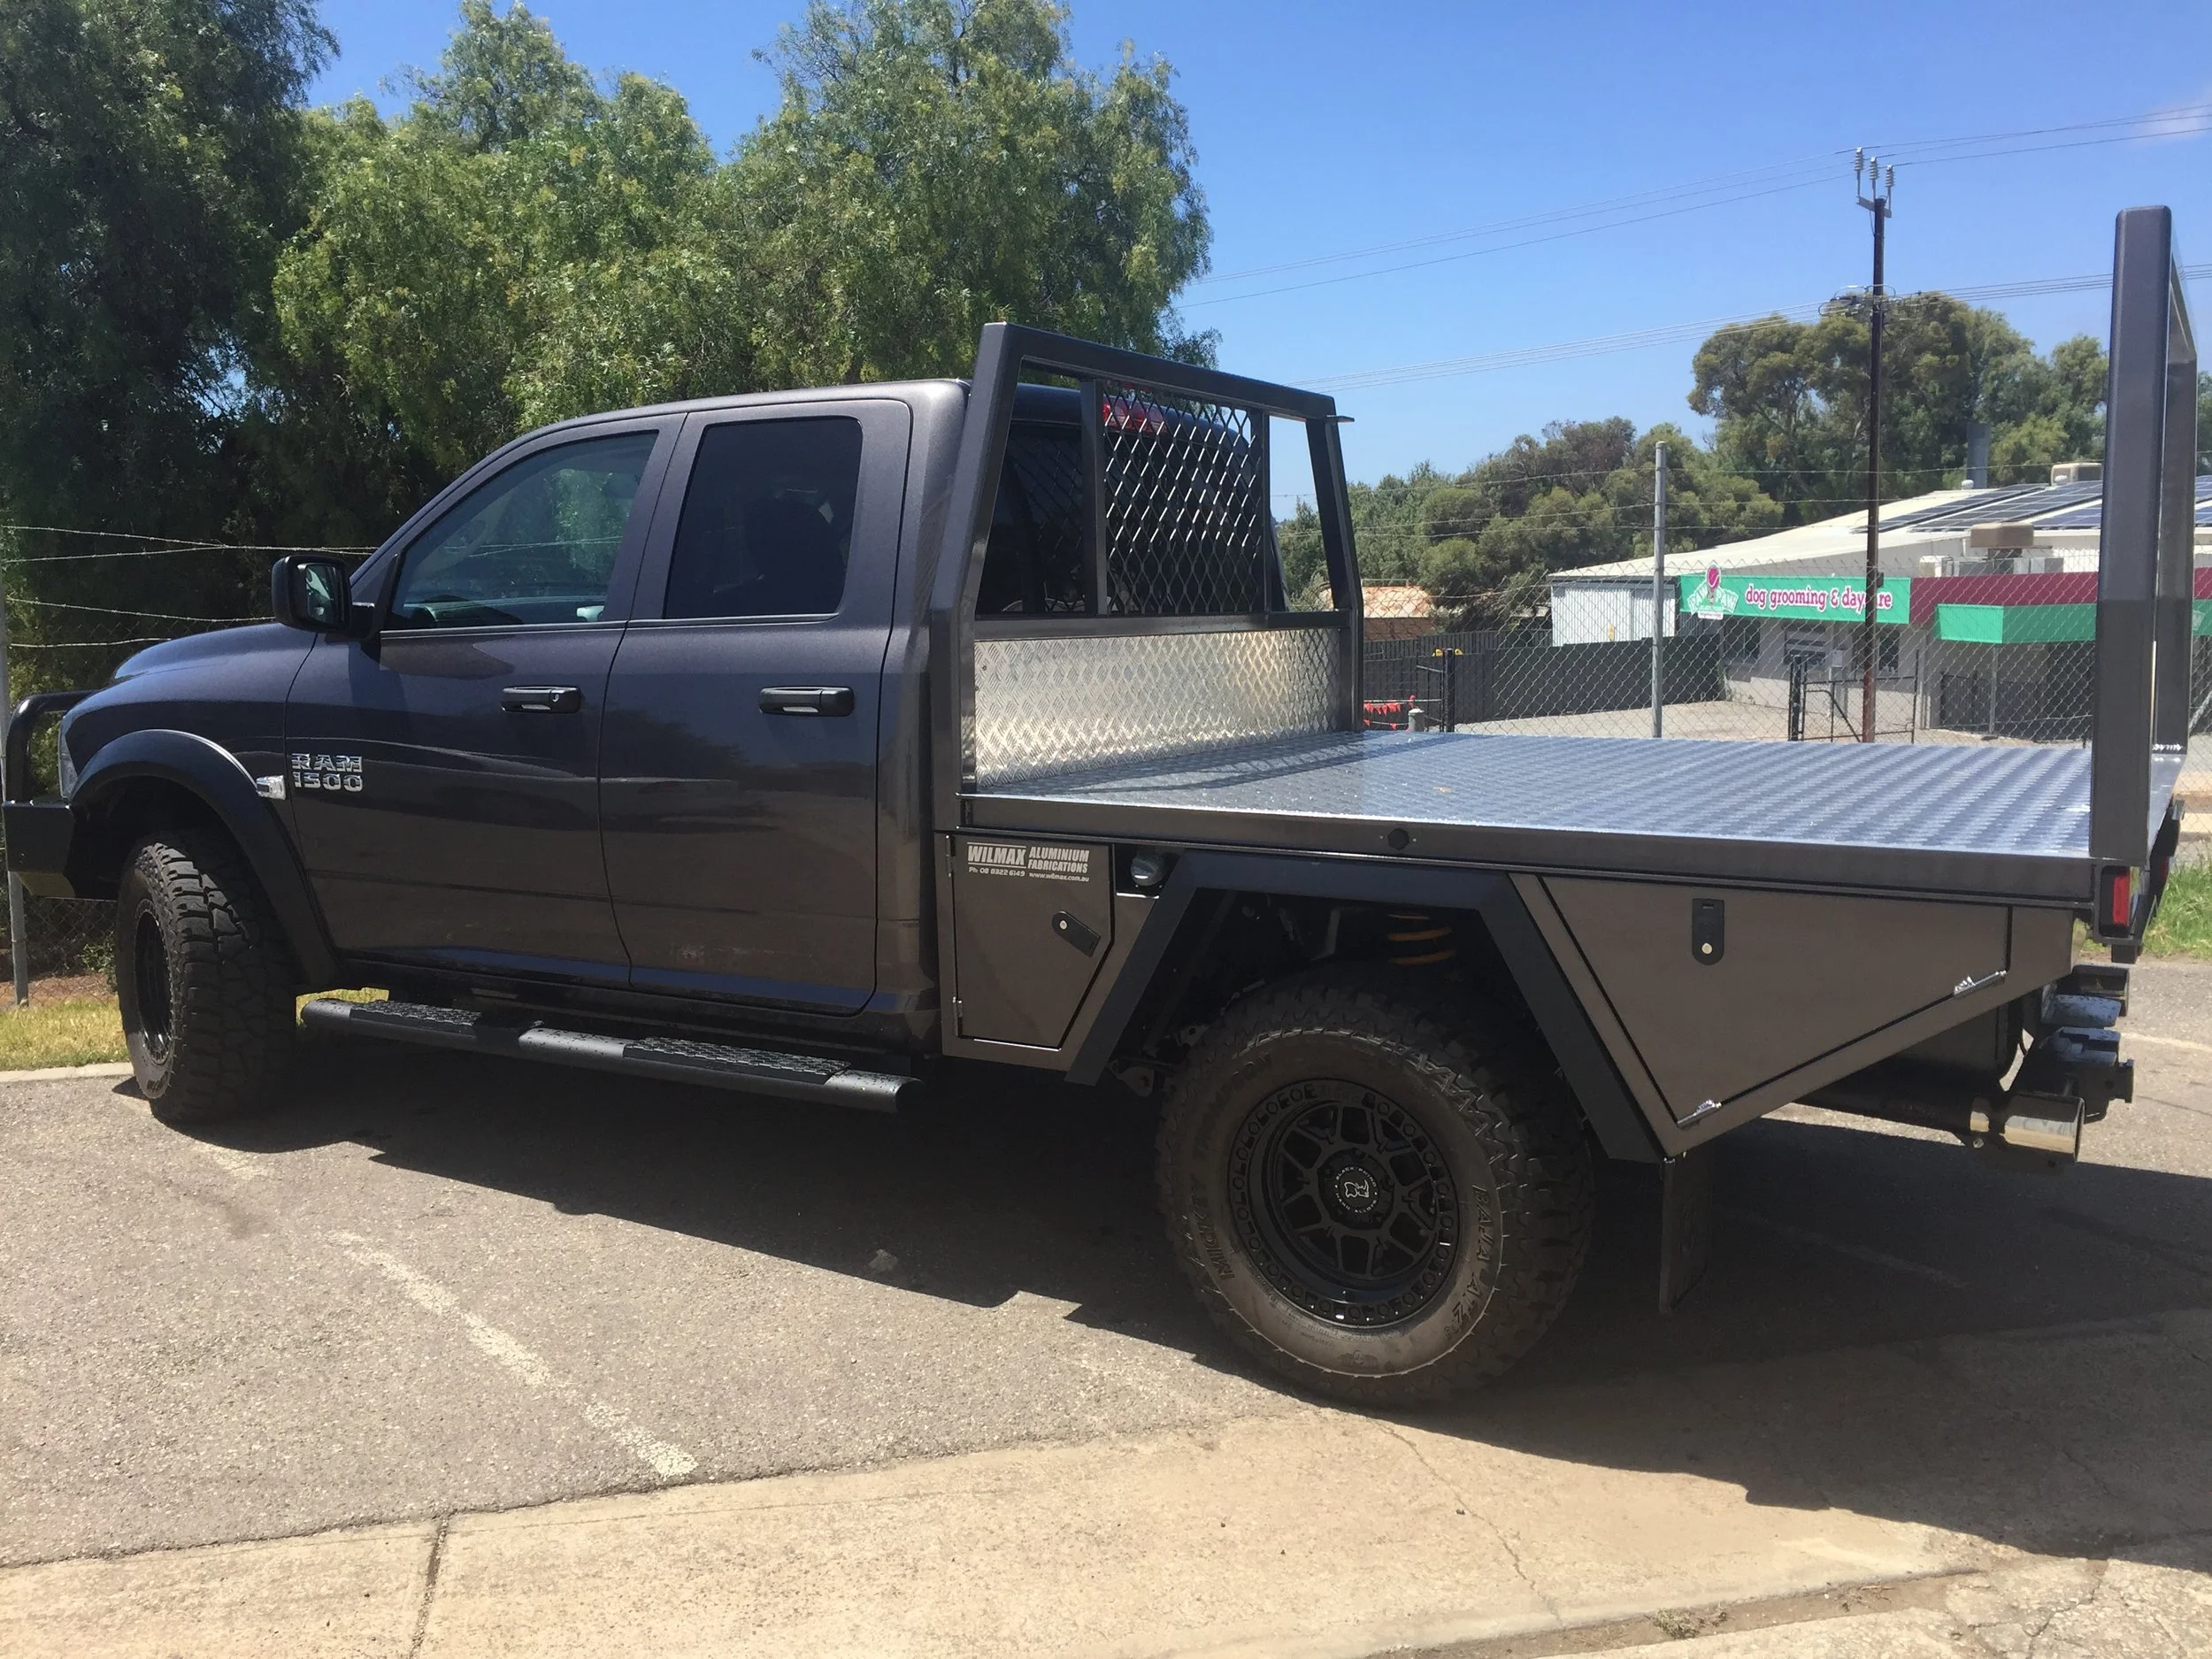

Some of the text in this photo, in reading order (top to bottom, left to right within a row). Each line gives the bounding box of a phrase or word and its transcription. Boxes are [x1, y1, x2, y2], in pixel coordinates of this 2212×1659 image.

[1746, 584, 1892, 613] dog grooming & dayre
[291, 753, 363, 772] RAM
[292, 772, 364, 793] 1500
[967, 845, 1026, 865] WILMAX
[1029, 846, 1090, 863] ALUMINIUM
[1027, 859, 1088, 874] FABRICATIONS
[1029, 872, 1090, 883] www.wilmax.com.au
[1471, 1184, 1494, 1262] BAJA
